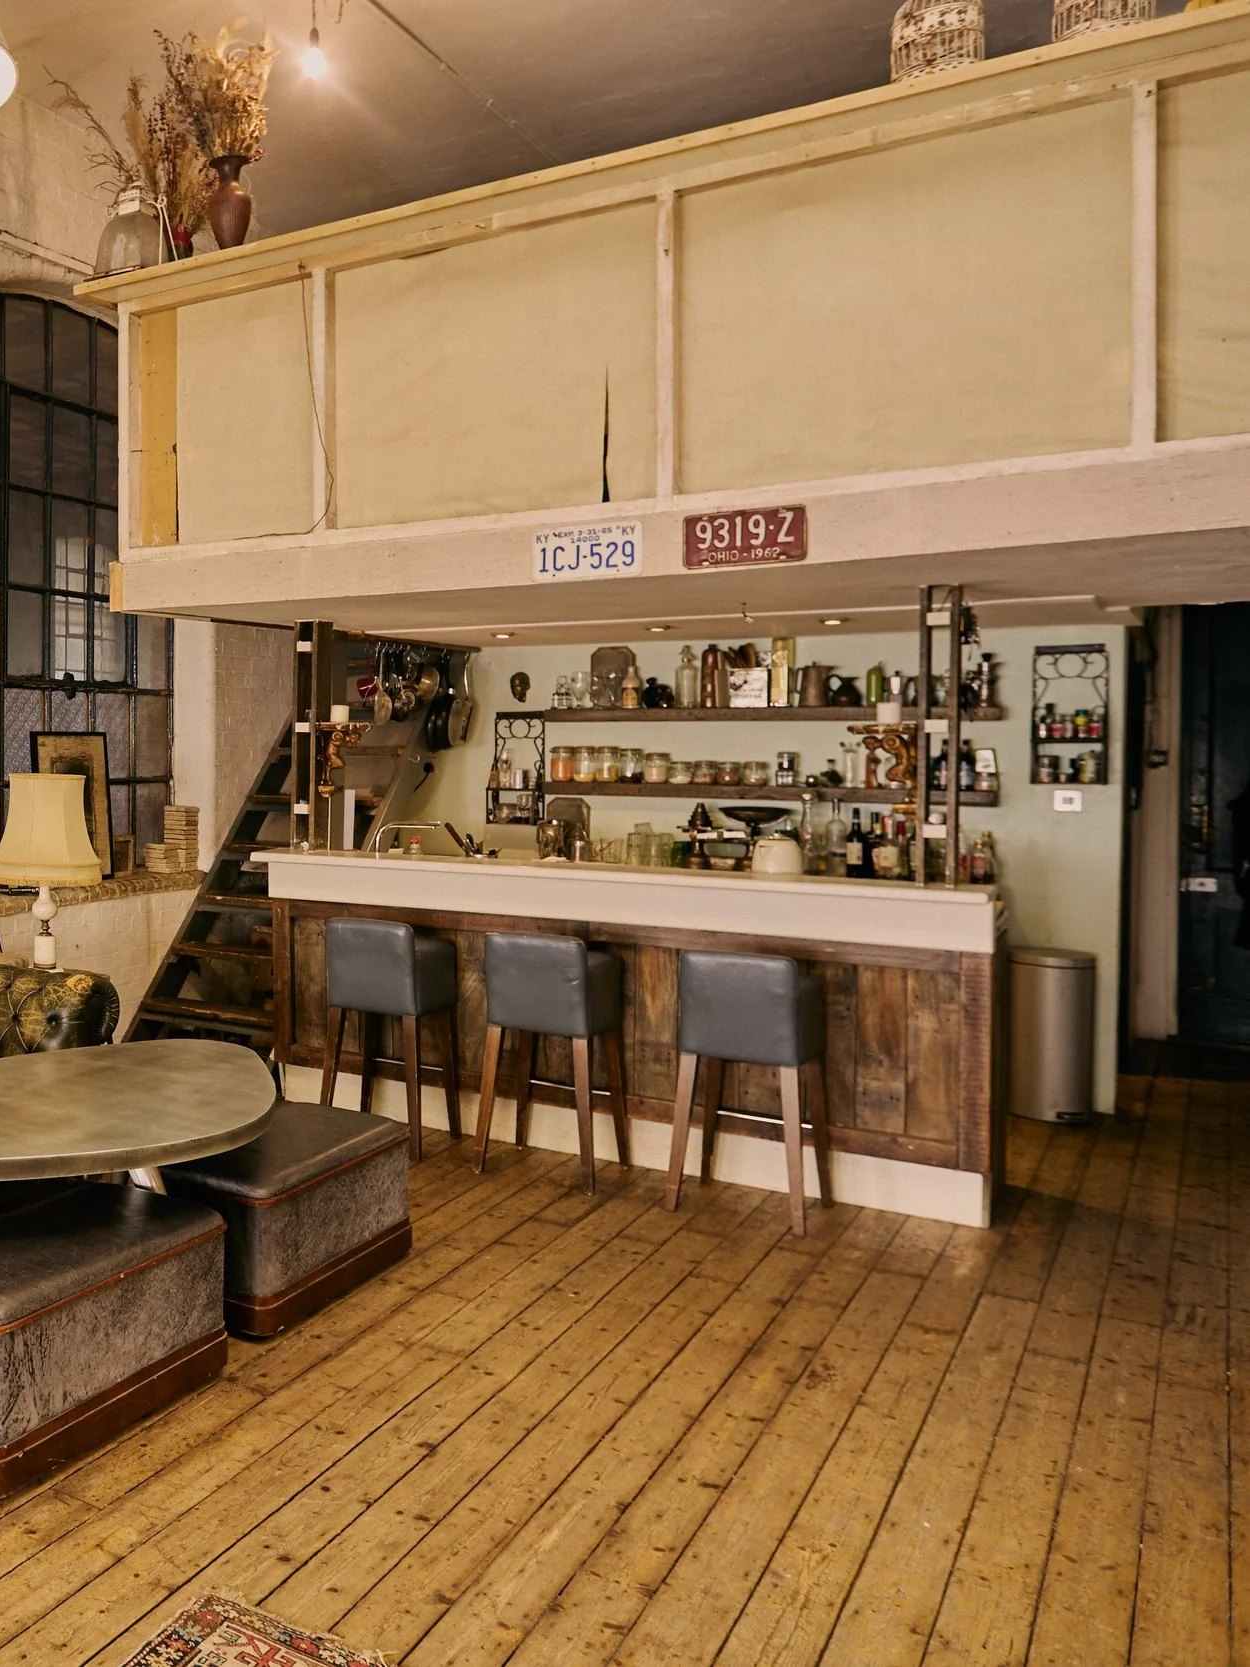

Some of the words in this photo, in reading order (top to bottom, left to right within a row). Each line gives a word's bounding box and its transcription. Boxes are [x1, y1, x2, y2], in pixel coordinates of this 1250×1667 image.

[536, 533, 550, 544] KY
[621, 525, 636, 536] KY
[539, 540, 635, 573] 1CJ-529
[708, 550, 740, 563] OHIO
[750, 547, 780, 559] 1962
